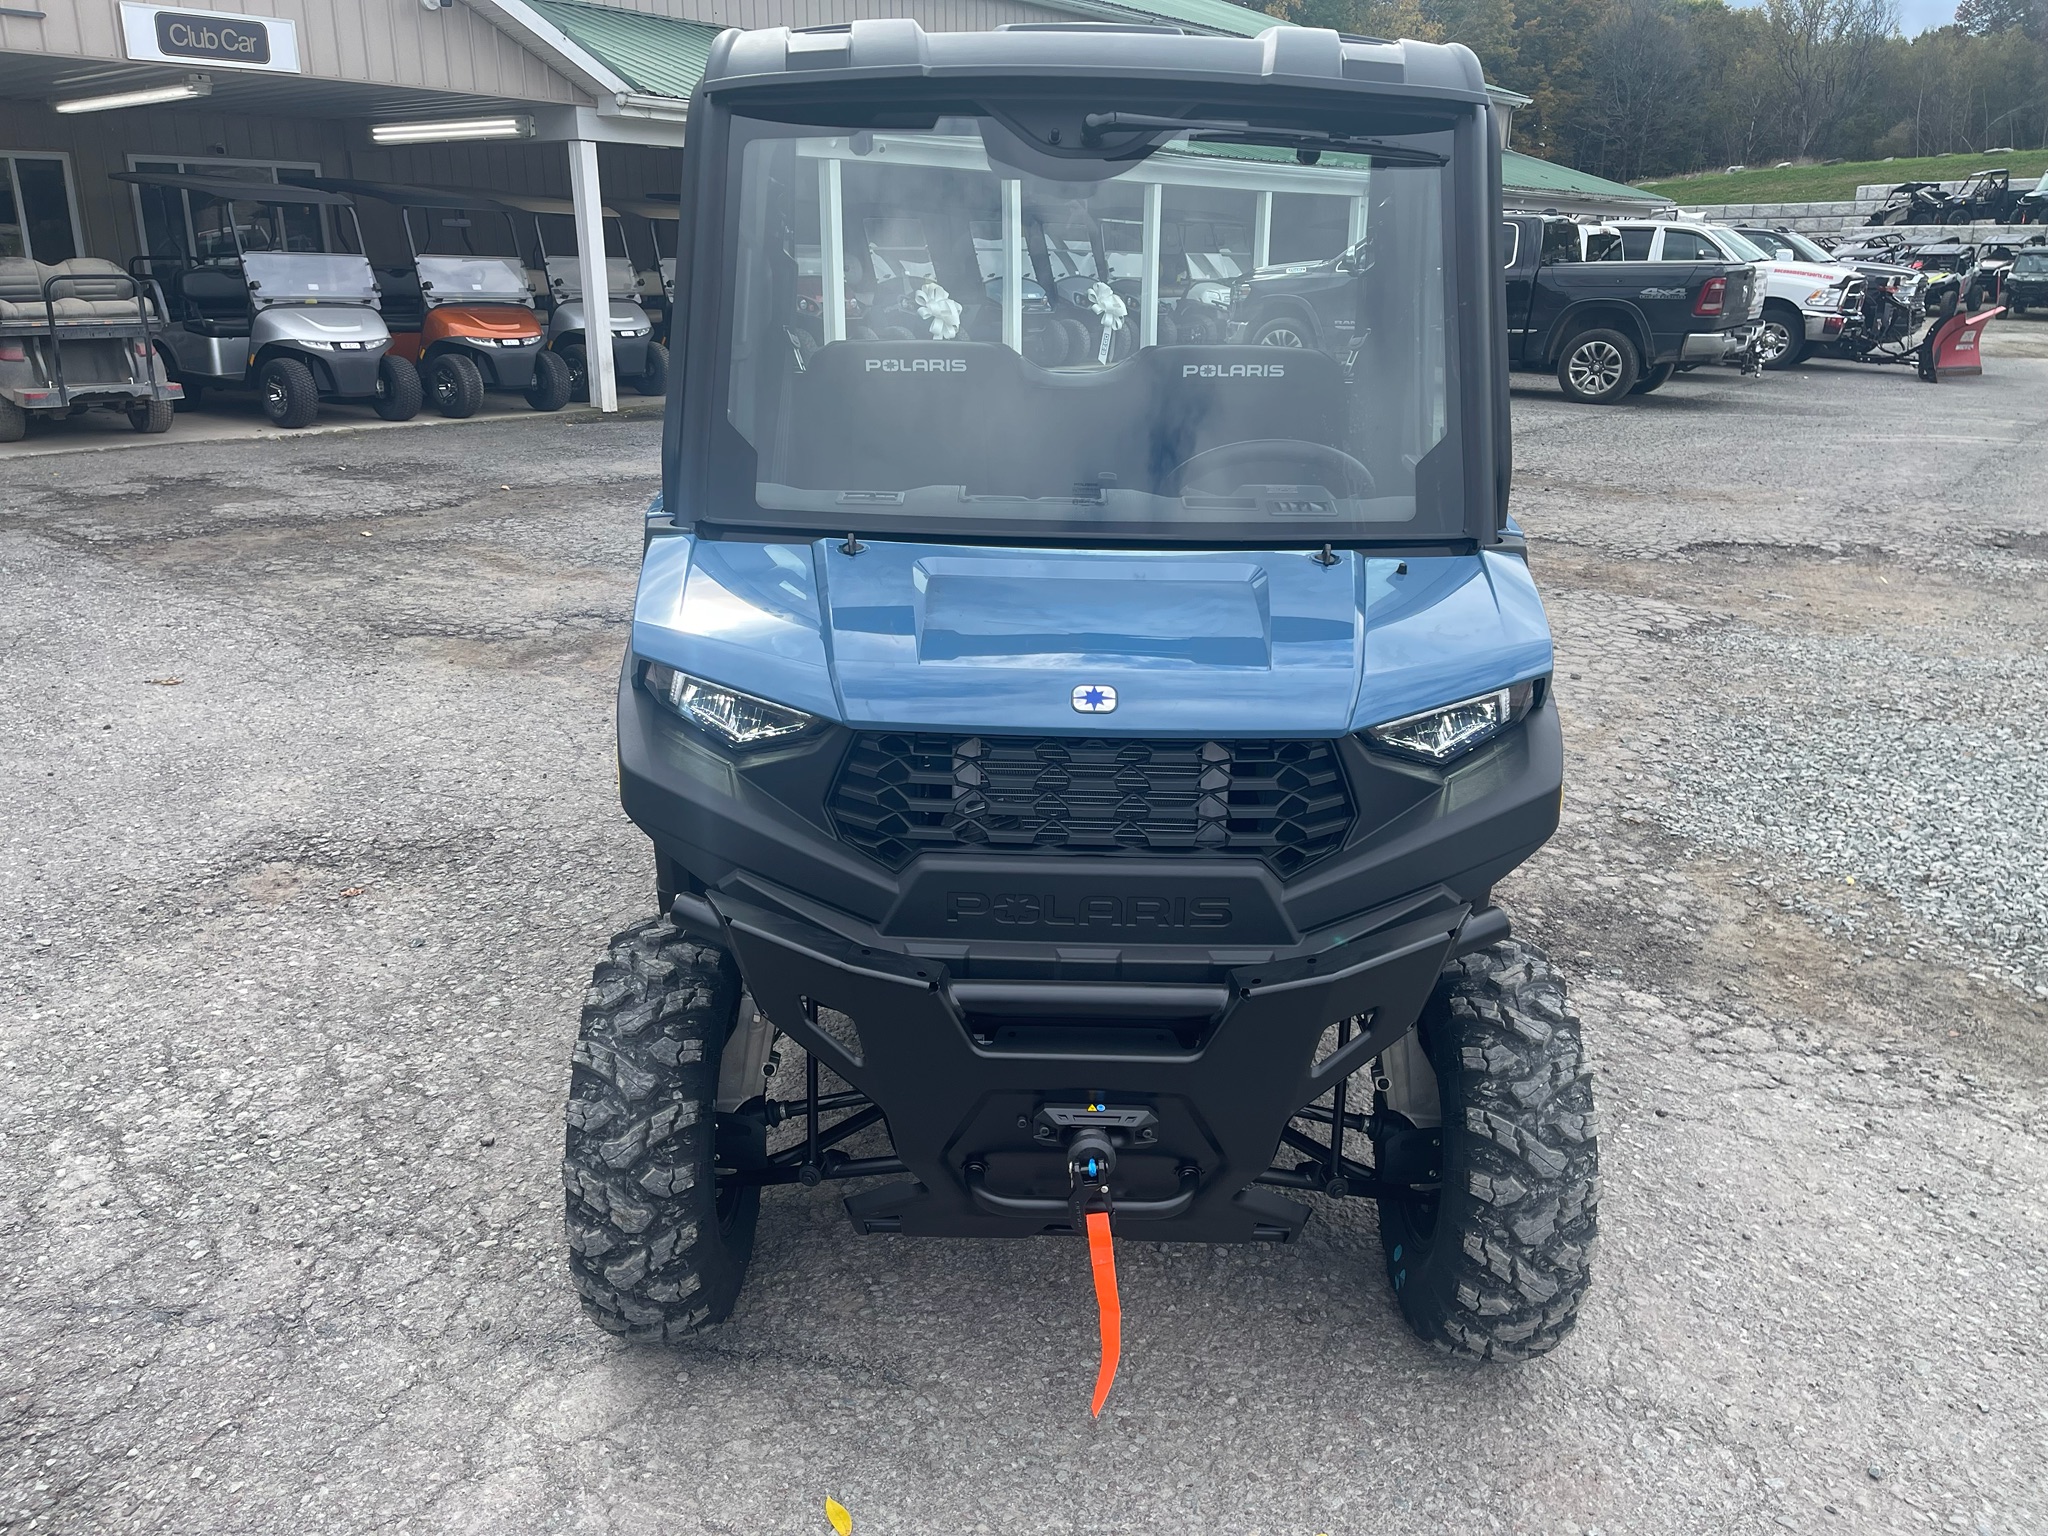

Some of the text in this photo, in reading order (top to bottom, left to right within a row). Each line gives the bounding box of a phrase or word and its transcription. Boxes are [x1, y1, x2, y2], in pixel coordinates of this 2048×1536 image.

[169, 23, 257, 53] Club Car
[865, 359, 968, 372] POLARIS
[1182, 364, 1285, 378] POLARIS
[946, 891, 1234, 928] POLARIS
